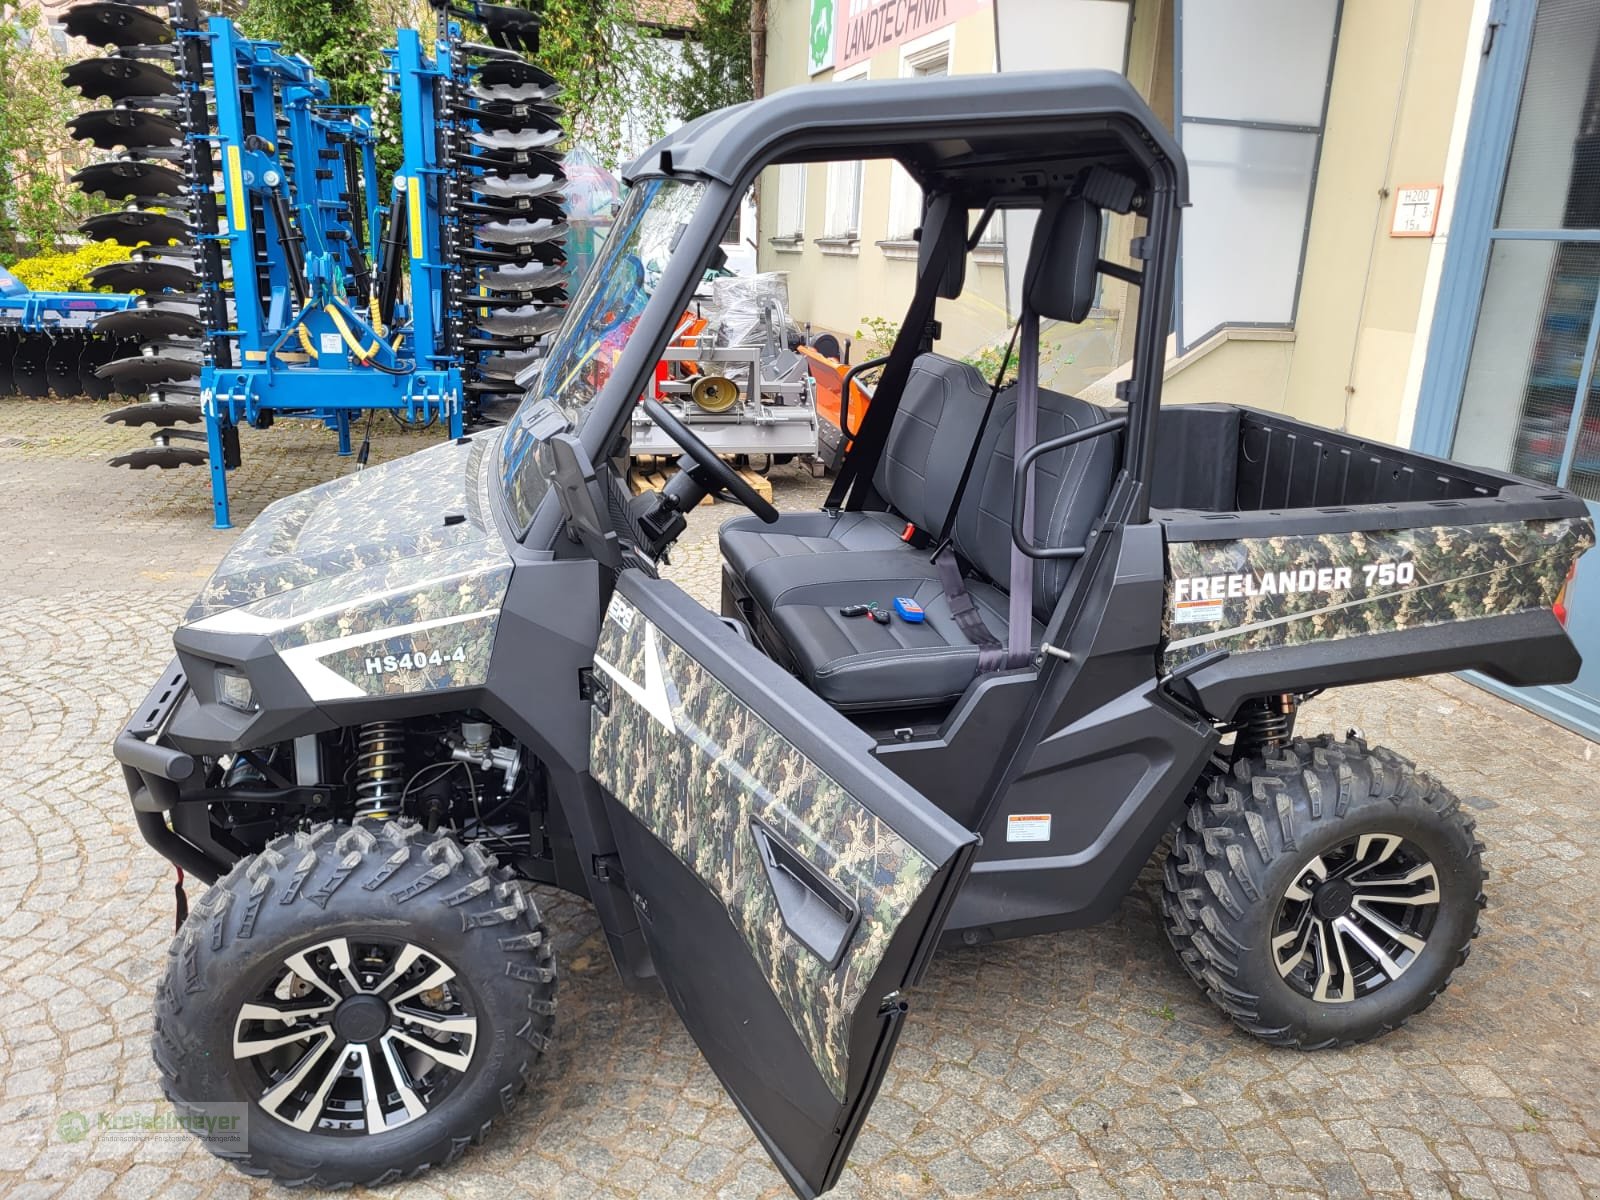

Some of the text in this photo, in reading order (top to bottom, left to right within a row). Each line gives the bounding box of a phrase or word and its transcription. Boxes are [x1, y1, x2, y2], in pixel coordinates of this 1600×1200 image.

[1405, 190, 1430, 202] H200
[1175, 562, 1414, 600] FREELANDER 750
[365, 646, 466, 675] HS404-4
